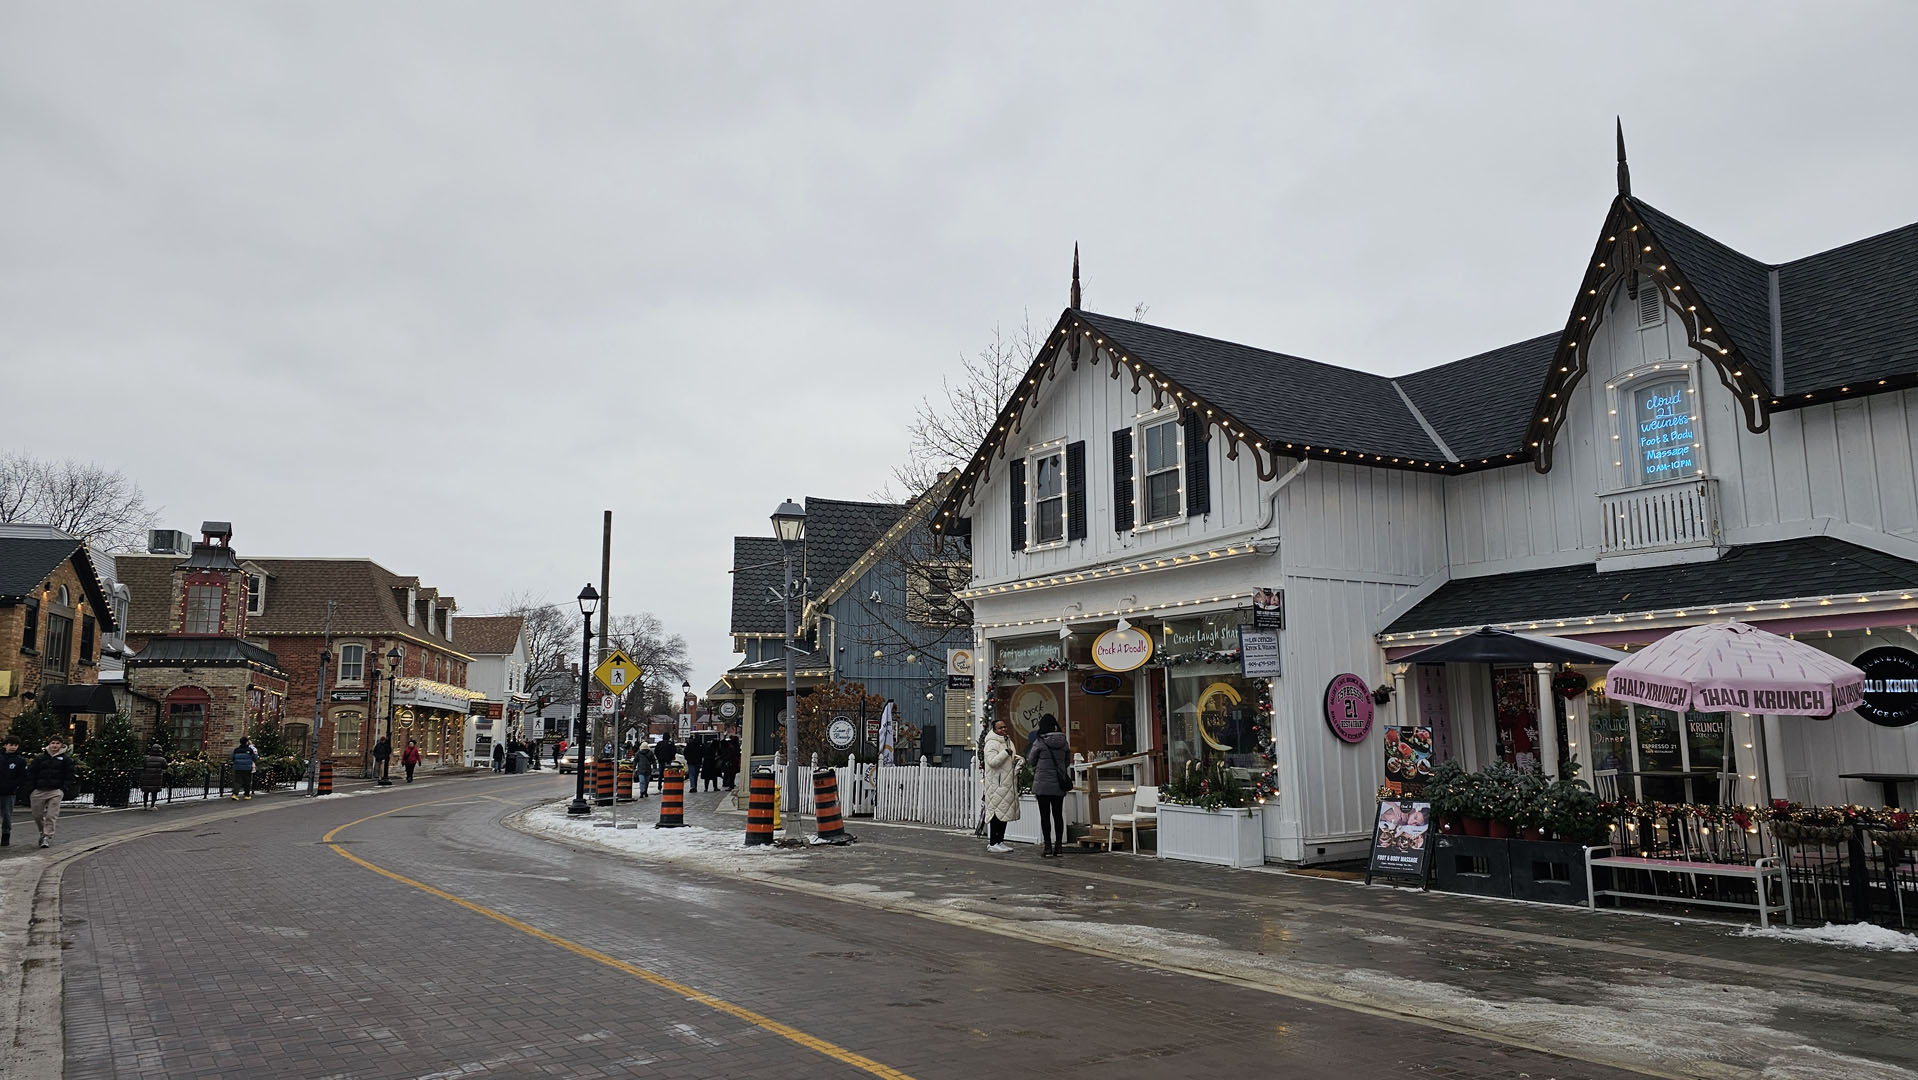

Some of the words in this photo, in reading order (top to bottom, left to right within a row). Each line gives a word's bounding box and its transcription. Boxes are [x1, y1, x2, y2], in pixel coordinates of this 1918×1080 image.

[1656, 406, 1674, 419] 21
[1663, 434, 1668, 443] &
[1670, 429, 1693, 441] Body
[1647, 446, 1689, 460] Massage
[1173, 632, 1195, 645] Create
[1197, 625, 1219, 646] Laugh
[1221, 624, 1238, 640] Shar
[1097, 642, 1116, 656] Crock
[1117, 643, 1122, 654] A
[1124, 640, 1146, 654] Doodle
[1863, 679, 1883, 693] ALO
[1885, 679, 1918, 693] KRUN
[1337, 686, 1364, 704] ESPRESSO
[1645, 682, 1687, 706] KRUNCH
[1753, 690, 1825, 709] KRUNCH
[1023, 701, 1044, 720] Crock
[1344, 699, 1358, 718] 21
[1873, 708, 1889, 718] ICE
[1690, 722, 1724, 733] KRUNCH
[1593, 732, 1625, 744] Dinner
